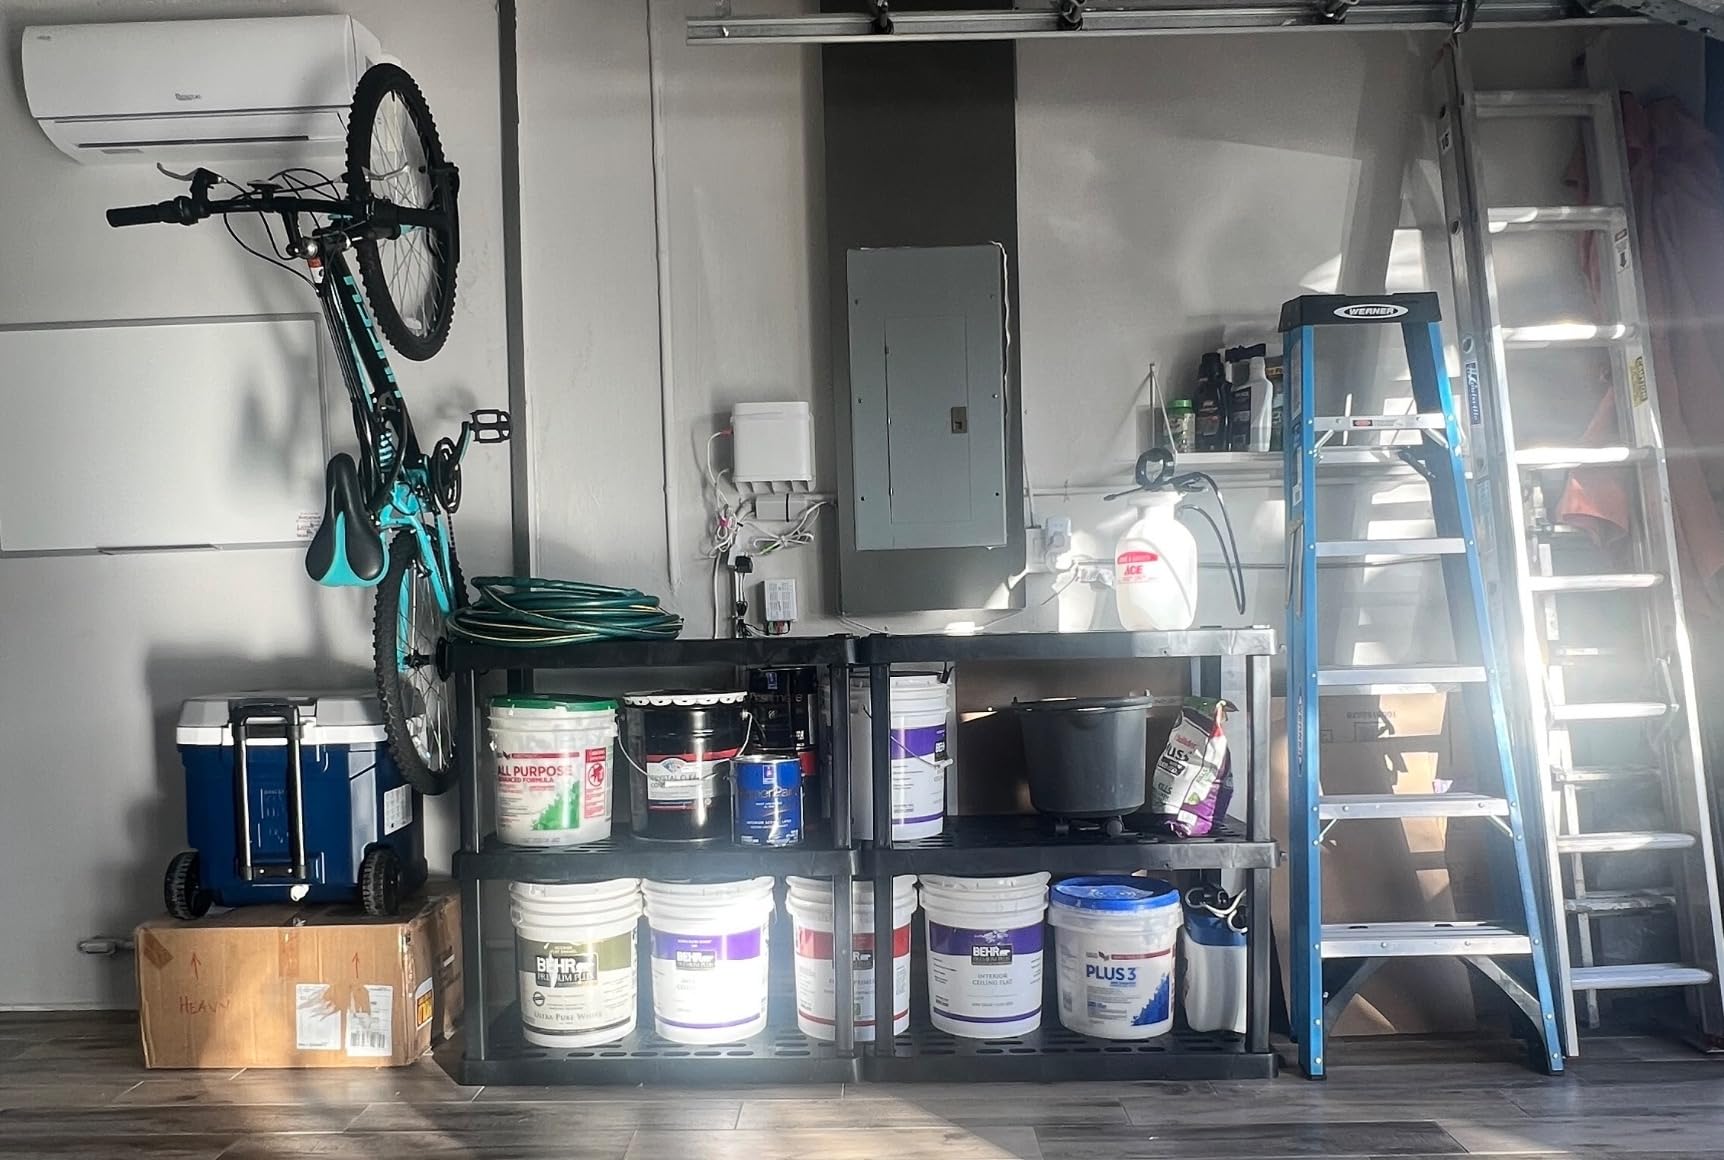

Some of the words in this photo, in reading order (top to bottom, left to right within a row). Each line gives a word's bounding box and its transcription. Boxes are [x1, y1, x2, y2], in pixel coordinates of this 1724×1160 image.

[1349, 307, 1394, 315] WERNER
[1124, 565, 1144, 576] ACE
[513, 764, 573, 777] PURPOSE
[677, 951, 702, 962] BEHR
[973, 946, 1000, 957] BEHR
[537, 972, 573, 982] PREUM
[1086, 964, 1125, 981] PLUS
[1127, 967, 1137, 981] 3
